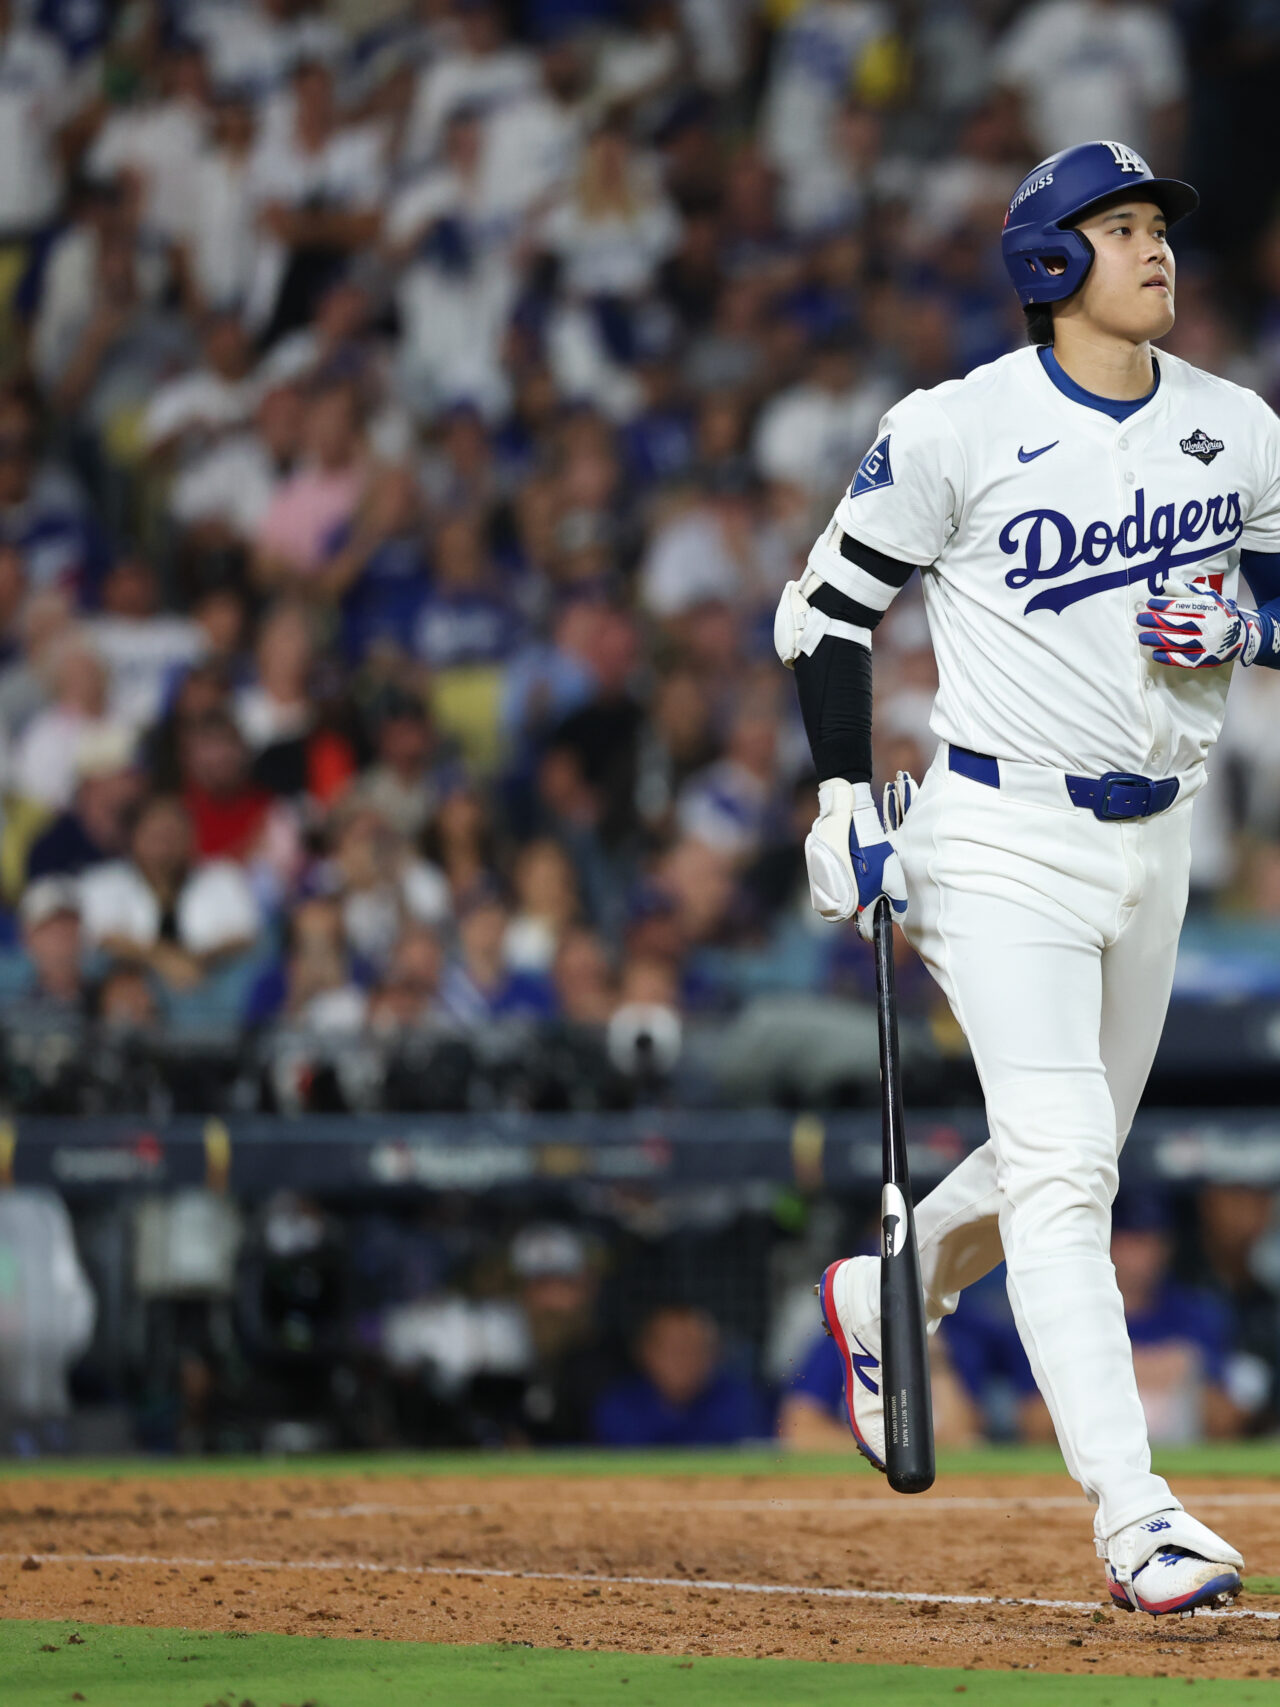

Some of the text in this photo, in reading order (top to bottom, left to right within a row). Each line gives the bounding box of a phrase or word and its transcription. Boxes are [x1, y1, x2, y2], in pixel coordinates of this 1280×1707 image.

[1100, 141, 1145, 173] LA
[1009, 172, 1054, 214] STRAUSS
[998, 487, 1245, 596] Dodgers
[1175, 601, 1219, 612] new balance
